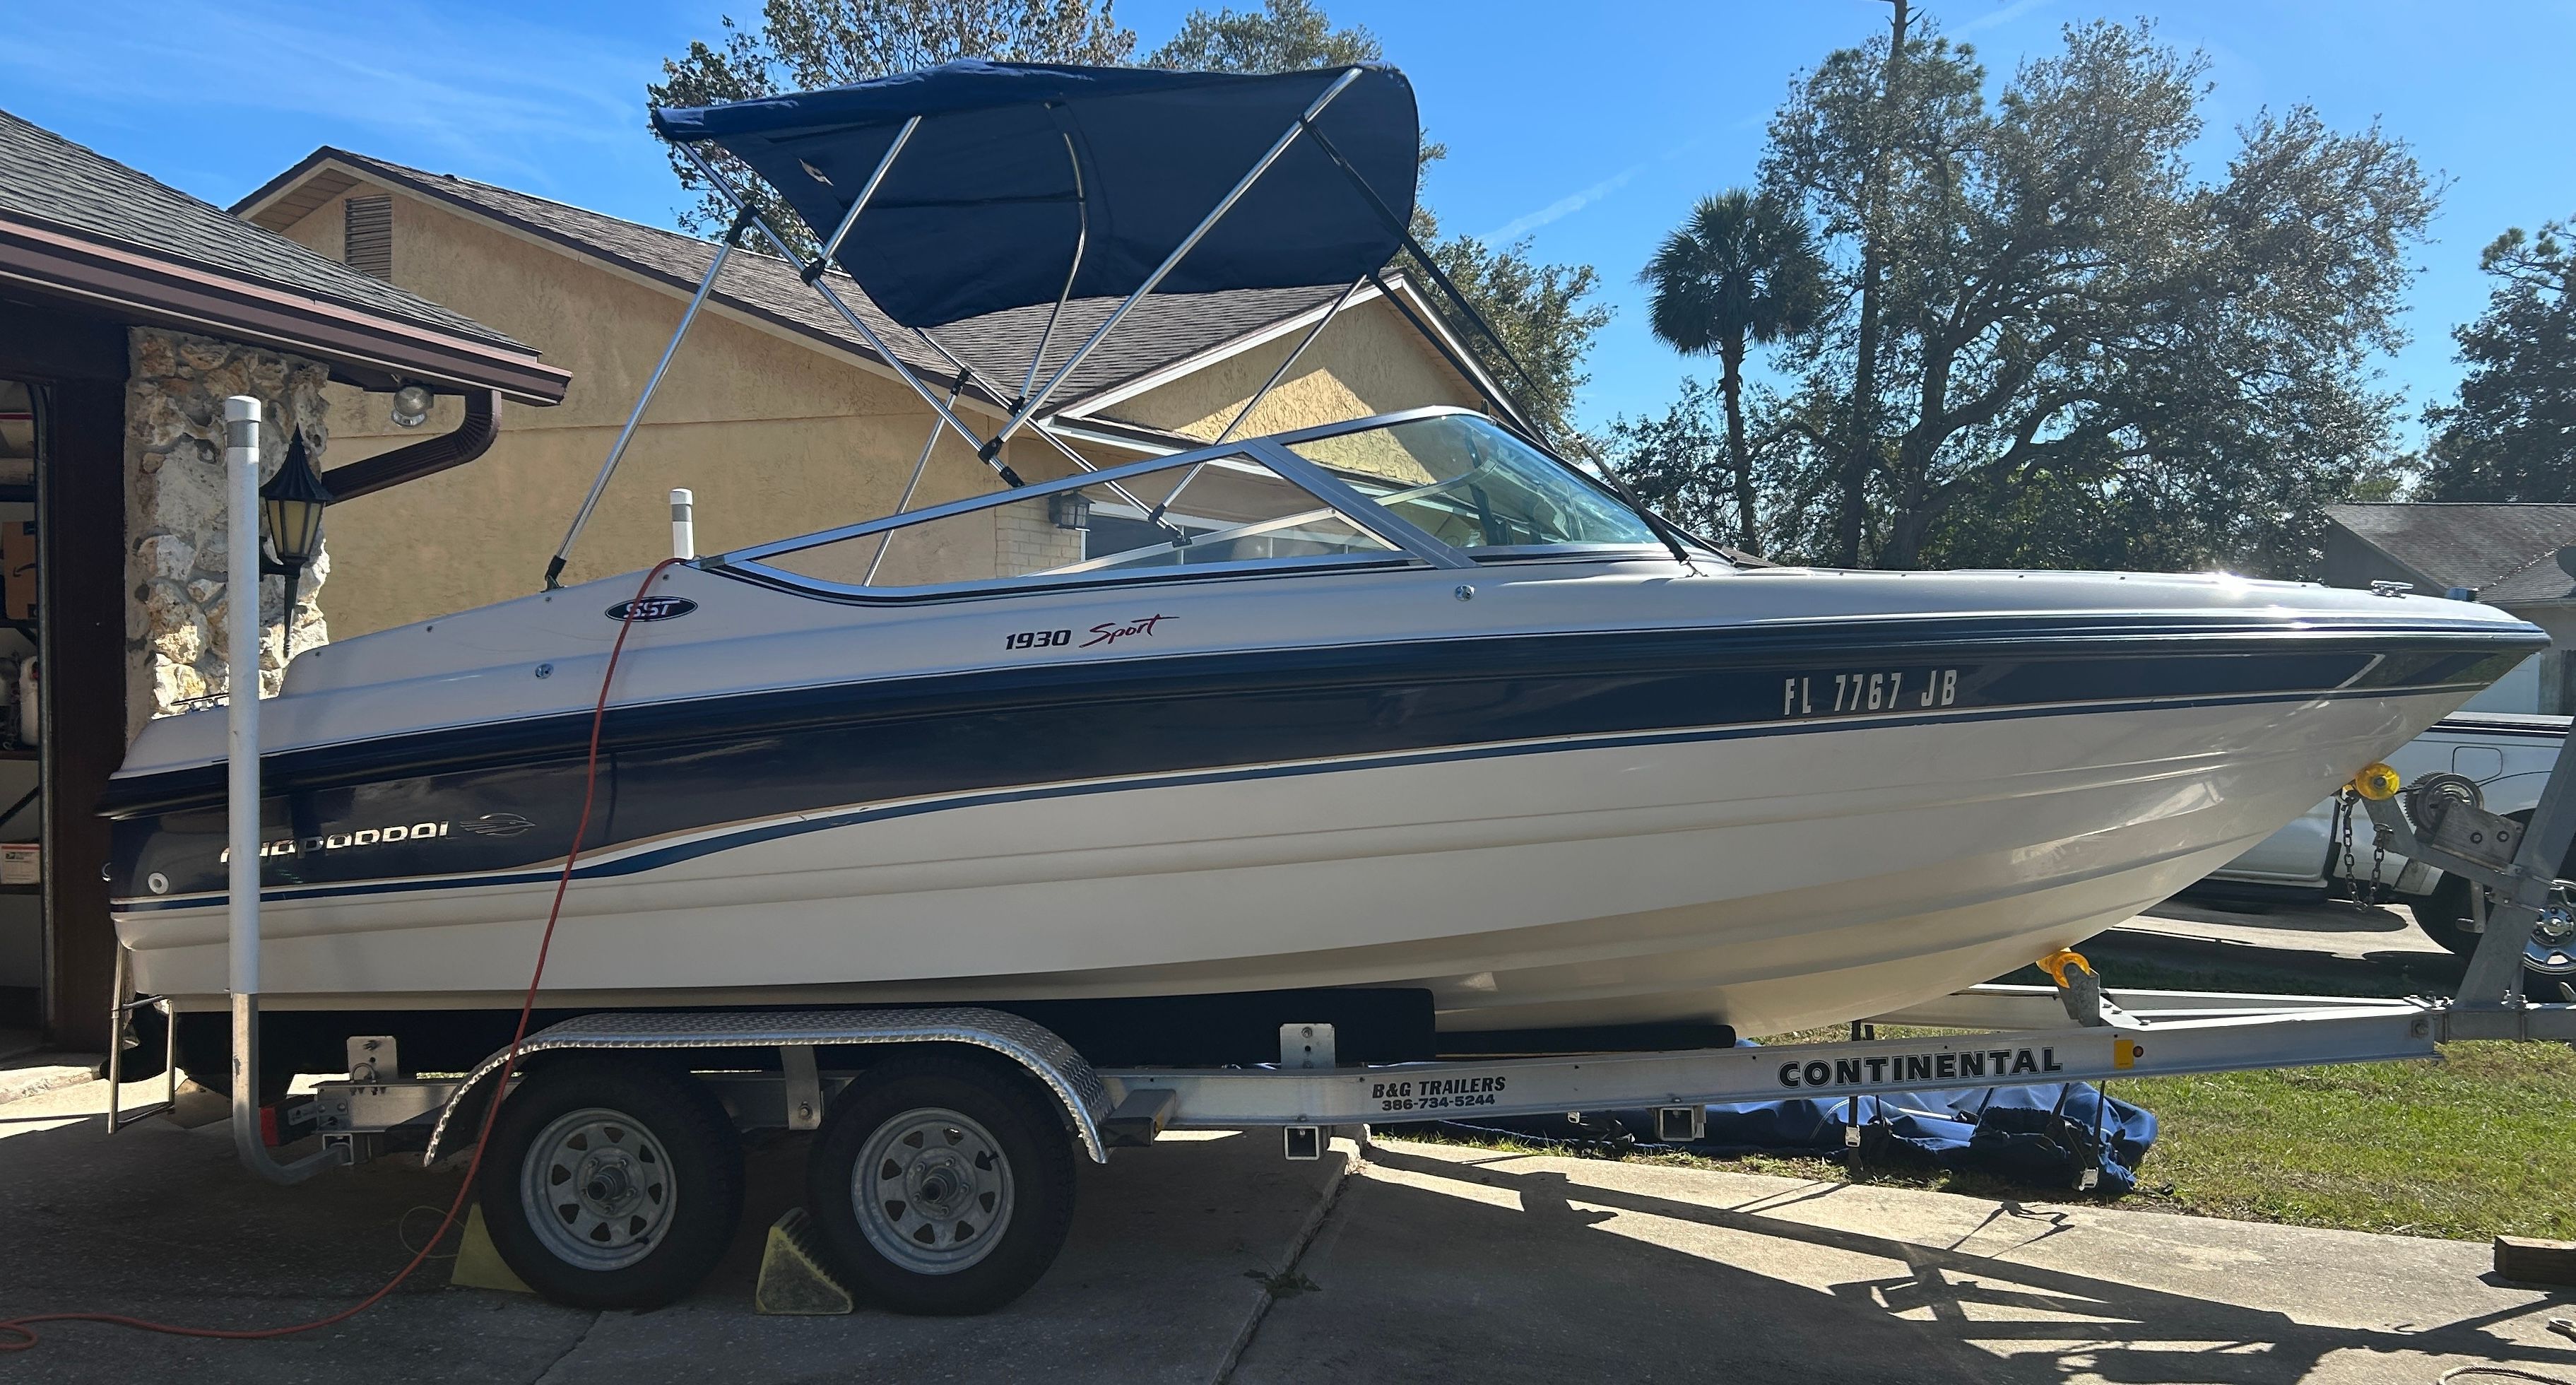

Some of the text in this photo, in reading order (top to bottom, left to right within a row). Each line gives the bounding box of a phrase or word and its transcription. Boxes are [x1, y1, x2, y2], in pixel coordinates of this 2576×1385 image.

[623, 600, 681, 618] SST
[1005, 613, 1181, 650] 1930 Sport
[1784, 669, 1957, 716] FL 7767 JB
[1778, 1046, 2064, 1089] CONTINENTAL
[1372, 1076, 1506, 1098] B&G TRAILERS
[1382, 1094, 1495, 1111] 386-734-5244
